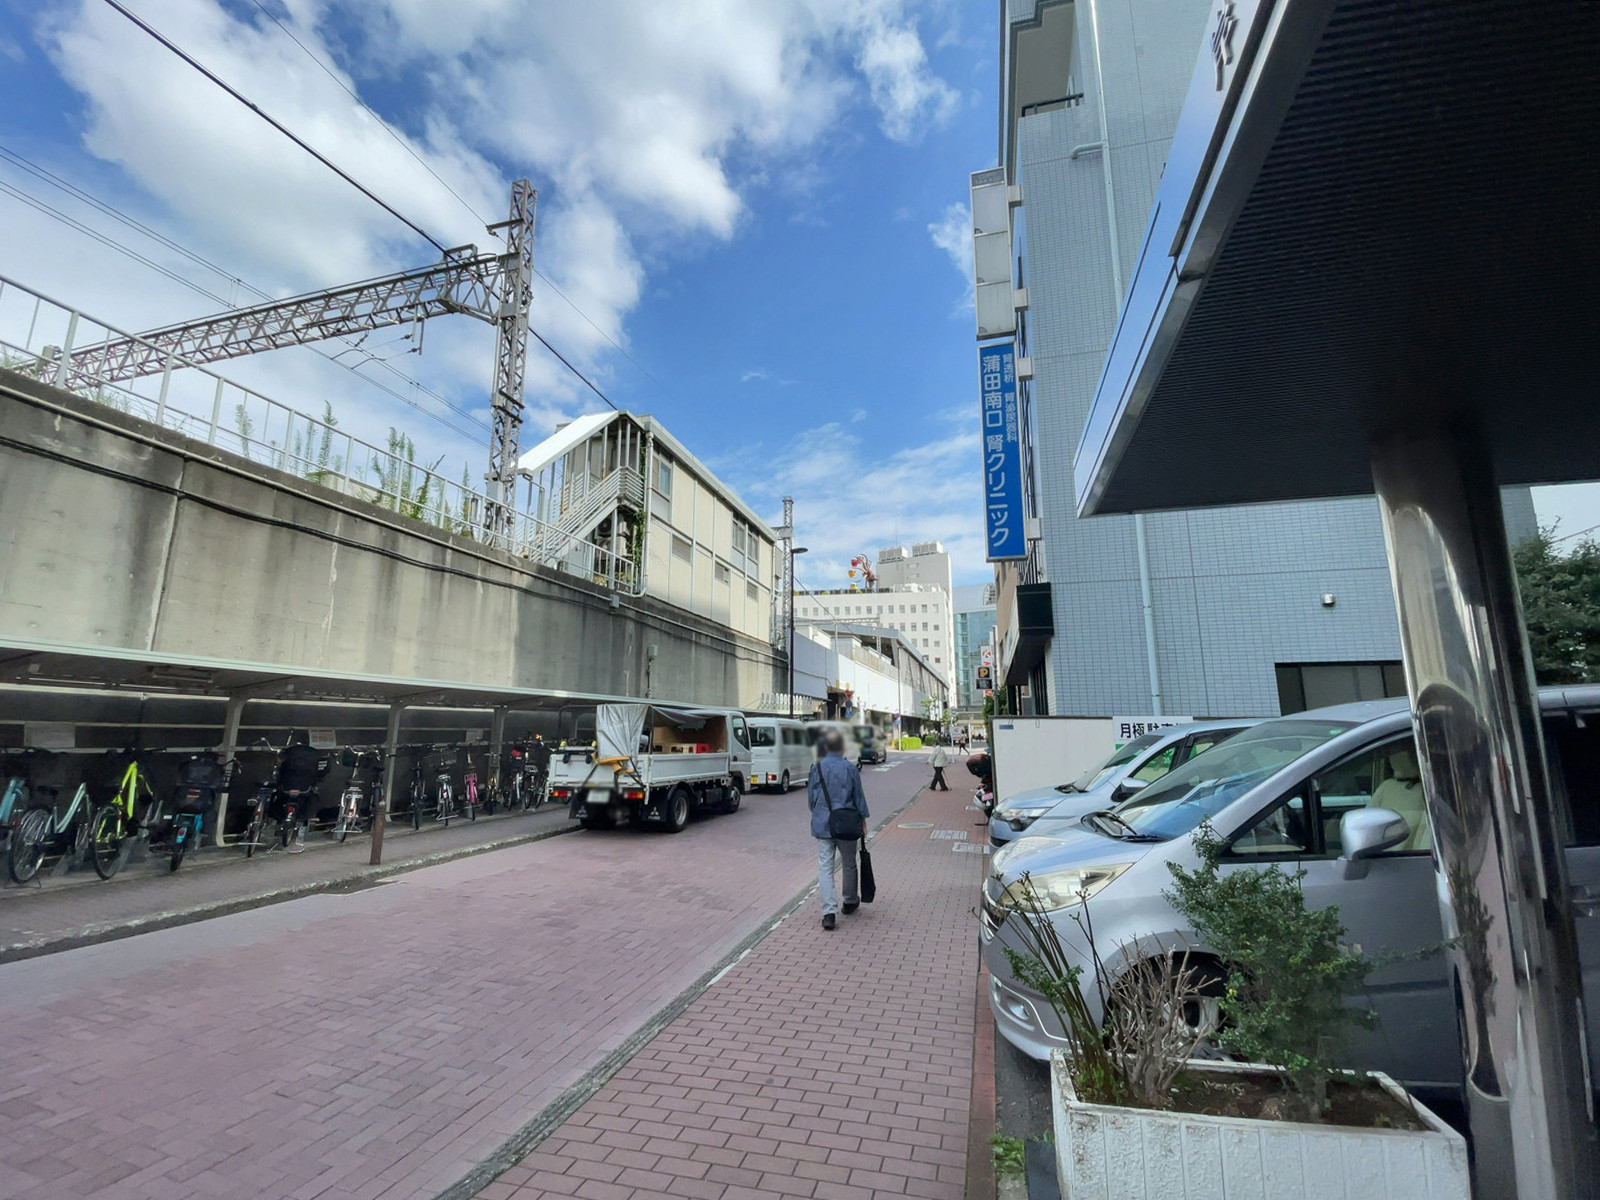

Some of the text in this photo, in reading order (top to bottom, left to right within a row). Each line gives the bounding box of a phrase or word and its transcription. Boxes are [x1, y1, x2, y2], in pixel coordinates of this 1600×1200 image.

[982, 354, 1009, 548] 蒲田南口 腎クリニック
